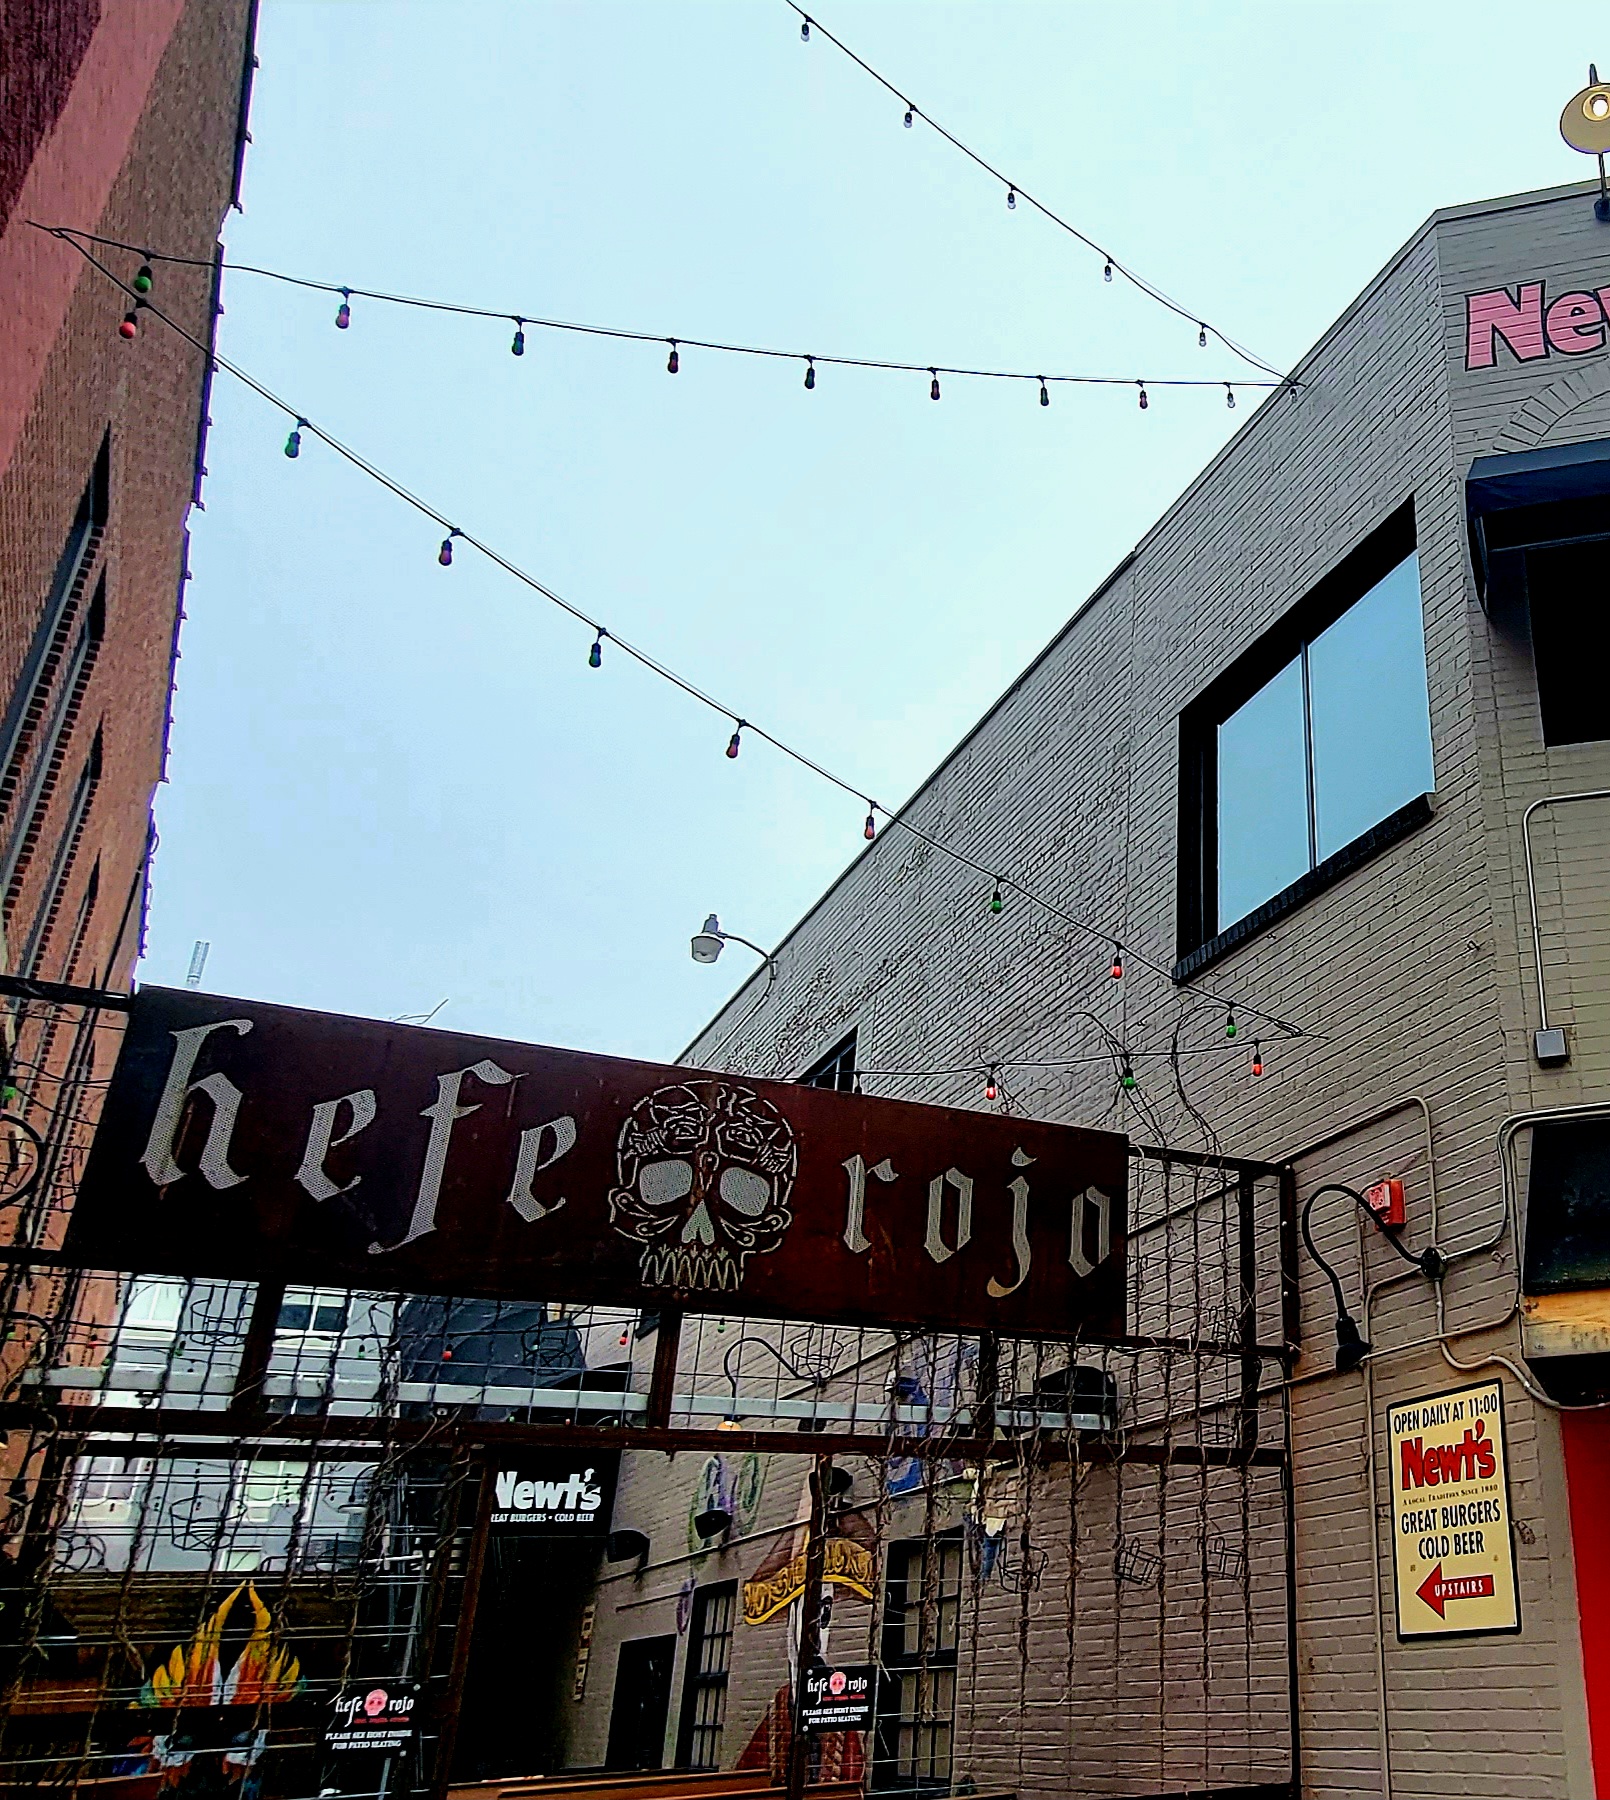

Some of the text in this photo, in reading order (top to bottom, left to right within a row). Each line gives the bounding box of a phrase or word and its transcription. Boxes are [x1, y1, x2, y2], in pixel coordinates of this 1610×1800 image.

[139, 1019, 1111, 1297] hefe rojo
[1394, 1393, 1497, 1434] OPEN DAILY AT 11:00
[1401, 1419, 1496, 1491] Newt's
[495, 1468, 601, 1510] Newt's
[510, 1513, 546, 1522] BURGERS
[554, 1513, 574, 1522] COLD
[576, 1513, 594, 1522] BEER
[1401, 1498, 1501, 1534] GREAT BURGERS
[1418, 1531, 1484, 1560] COLD BEER
[1434, 1580, 1483, 1597] UPSTAIRS
